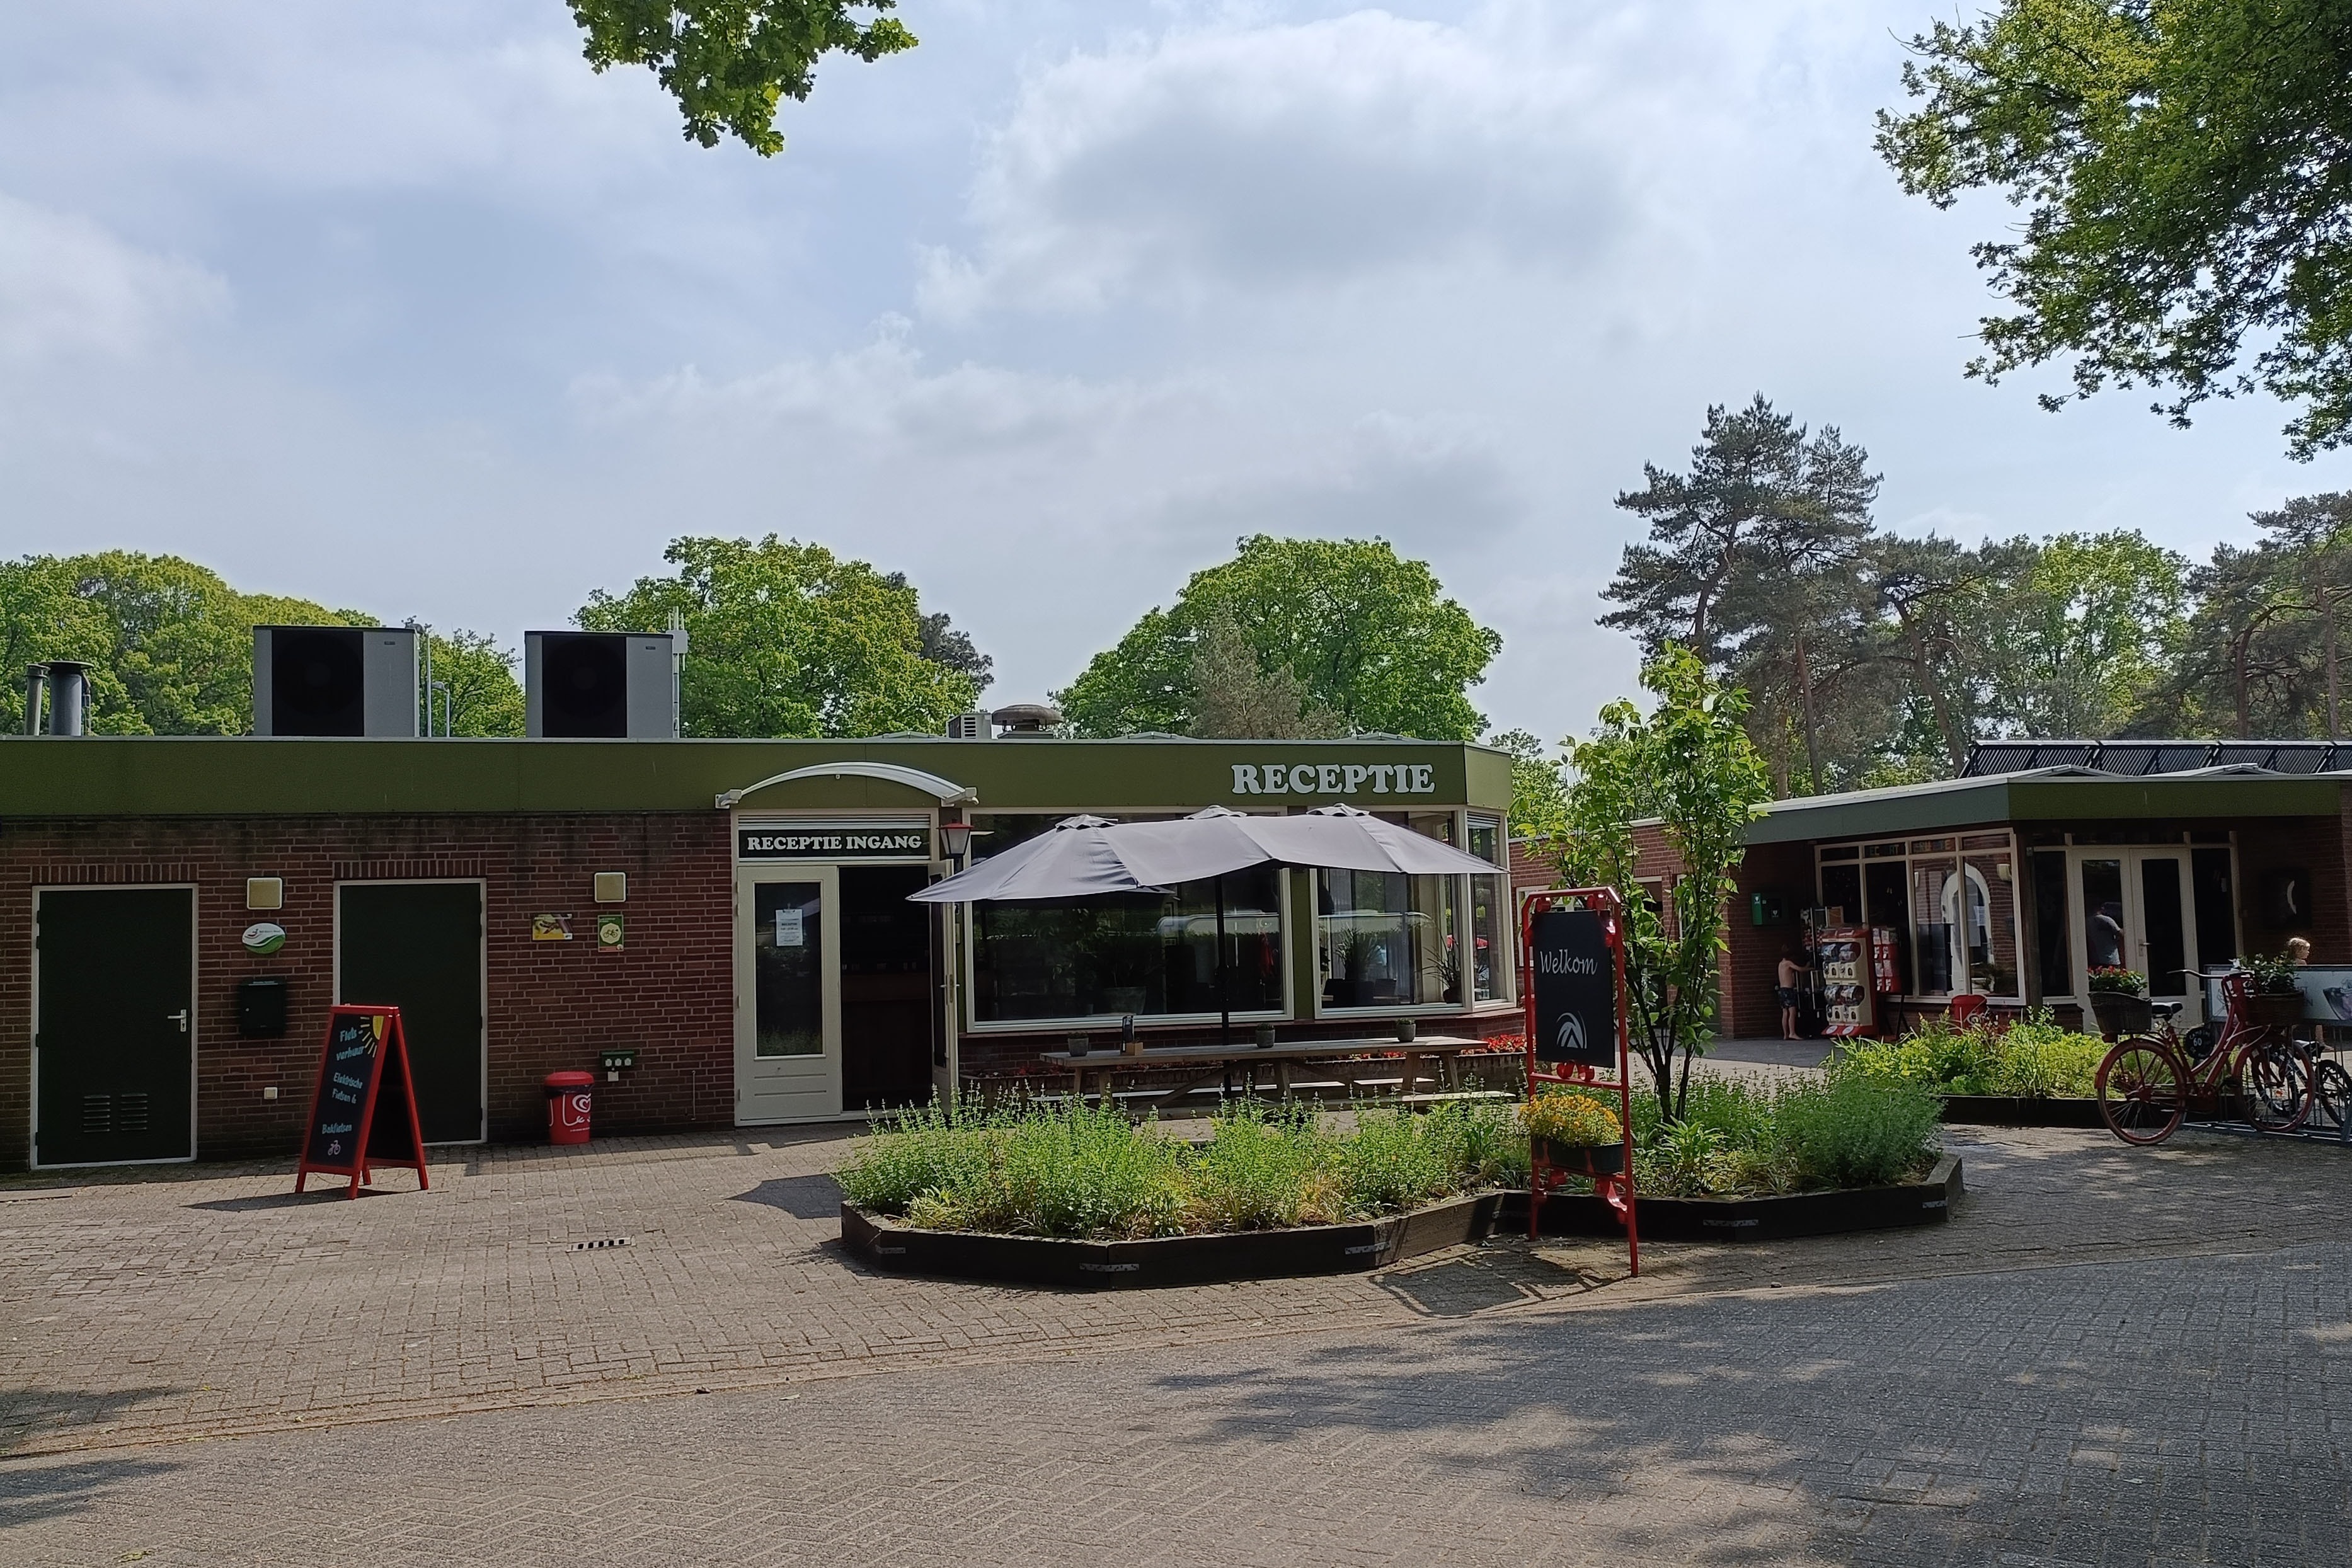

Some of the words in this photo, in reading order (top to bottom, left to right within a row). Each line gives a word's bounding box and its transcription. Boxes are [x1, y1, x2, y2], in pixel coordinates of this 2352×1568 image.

[1230, 764, 1436, 794] RECEPTIE
[747, 836, 842, 850] RECEPTIE
[846, 835, 923, 850] INGANG
[1539, 948, 1598, 975] Welkom
[2193, 1038, 2203, 1047] 60
